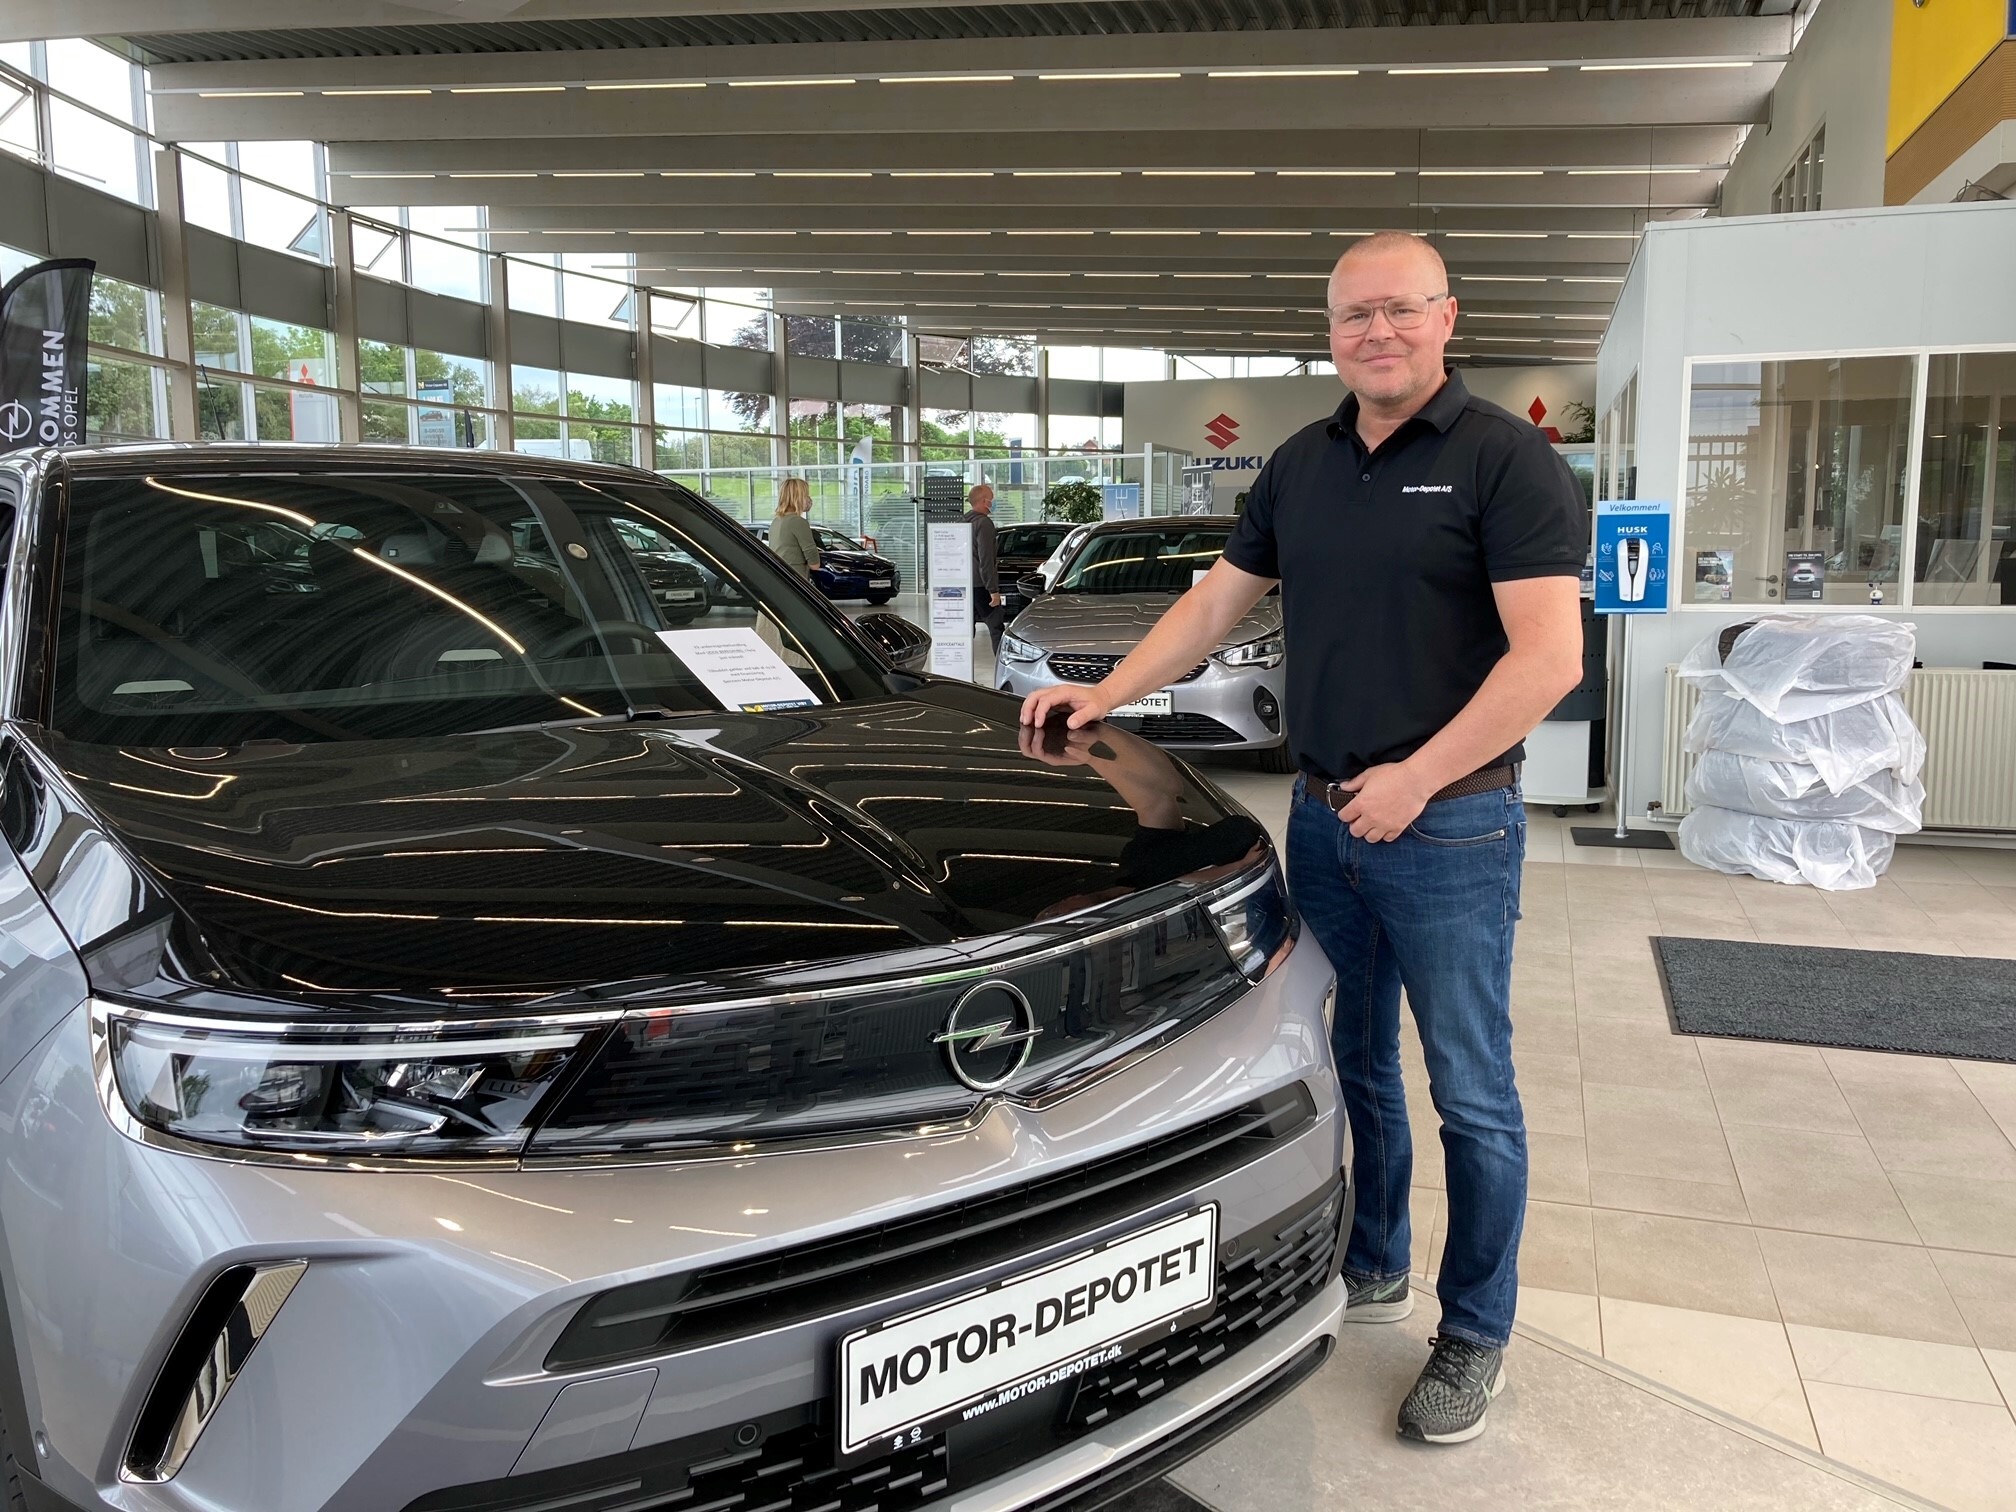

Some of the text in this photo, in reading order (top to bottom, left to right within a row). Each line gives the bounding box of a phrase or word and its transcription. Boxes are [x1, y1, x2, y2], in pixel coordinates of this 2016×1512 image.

[39, 330, 64, 447] OMMEN
[64, 387, 78, 427] OPEL
[1192, 456, 1263, 470] UZUKI
[1441, 485, 1452, 493] A/S
[1609, 504, 1661, 512] Velkommen!
[1128, 698, 1169, 707] POTET
[489, 1081, 528, 1094] LUX
[859, 1237, 1204, 1405] MOTOR-DEPOTET
[962, 1344, 1122, 1421] www.MOTOR-DEPOTET.dk
